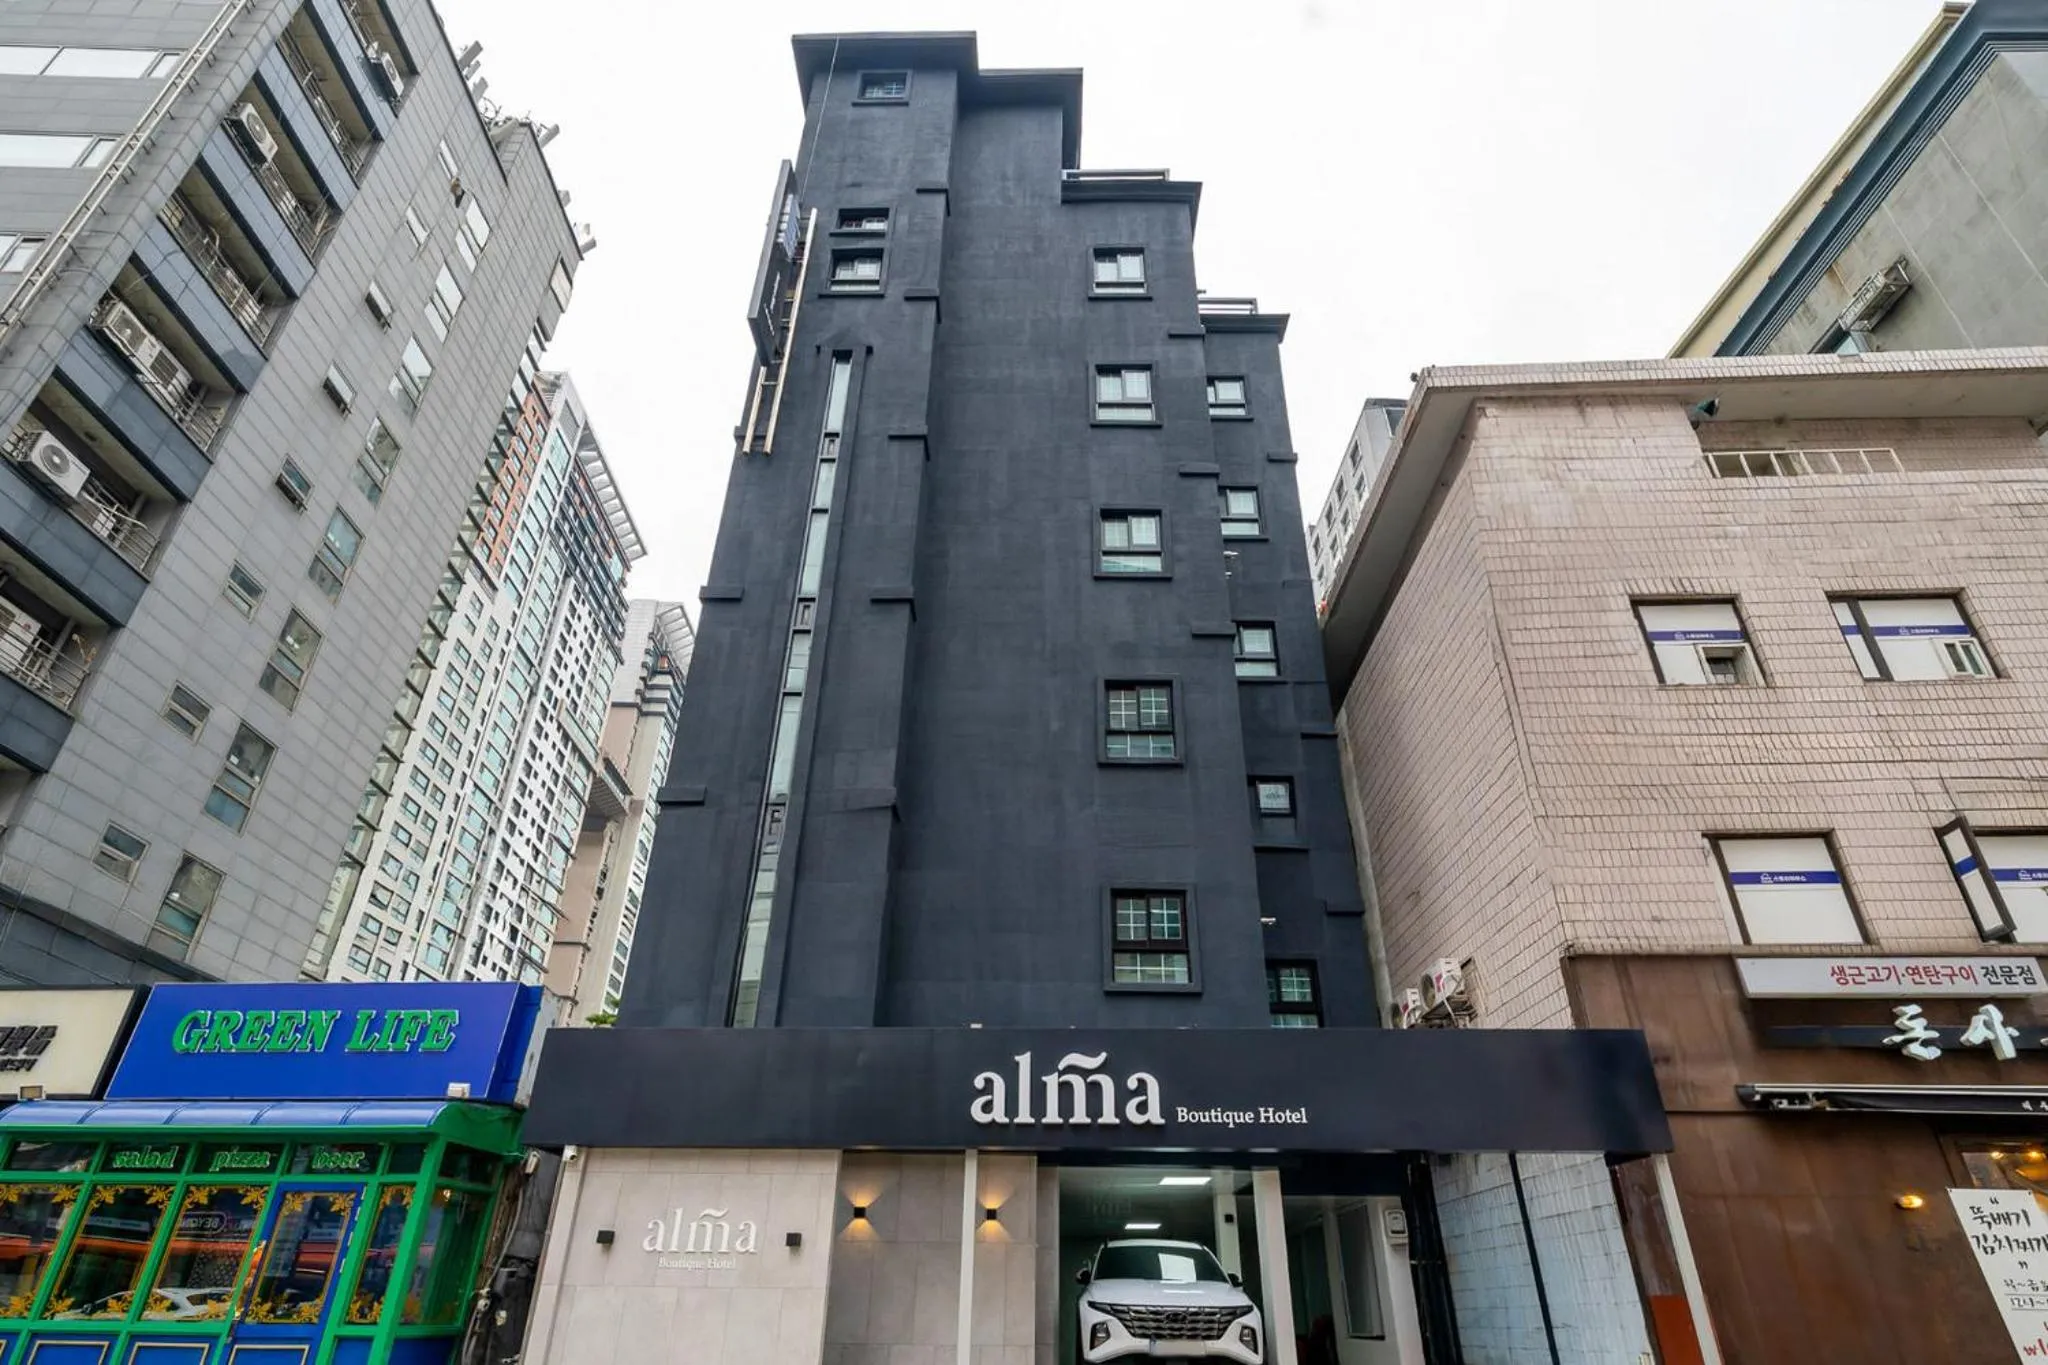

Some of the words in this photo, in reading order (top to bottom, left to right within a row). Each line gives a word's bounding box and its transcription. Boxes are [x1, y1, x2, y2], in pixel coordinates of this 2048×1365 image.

[1980, 965, 2037, 985] 전문점
[172, 1010, 341, 1053] GREEN
[344, 1010, 459, 1052] LIFE
[1176, 1107, 1254, 1128] Boutique
[1258, 1107, 1308, 1124] Hotel
[112, 1146, 179, 1169] salad
[208, 1146, 271, 1172] pizza
[311, 1148, 366, 1169] beer
[658, 1257, 705, 1272] Boutique
[707, 1258, 737, 1270] Hotel
